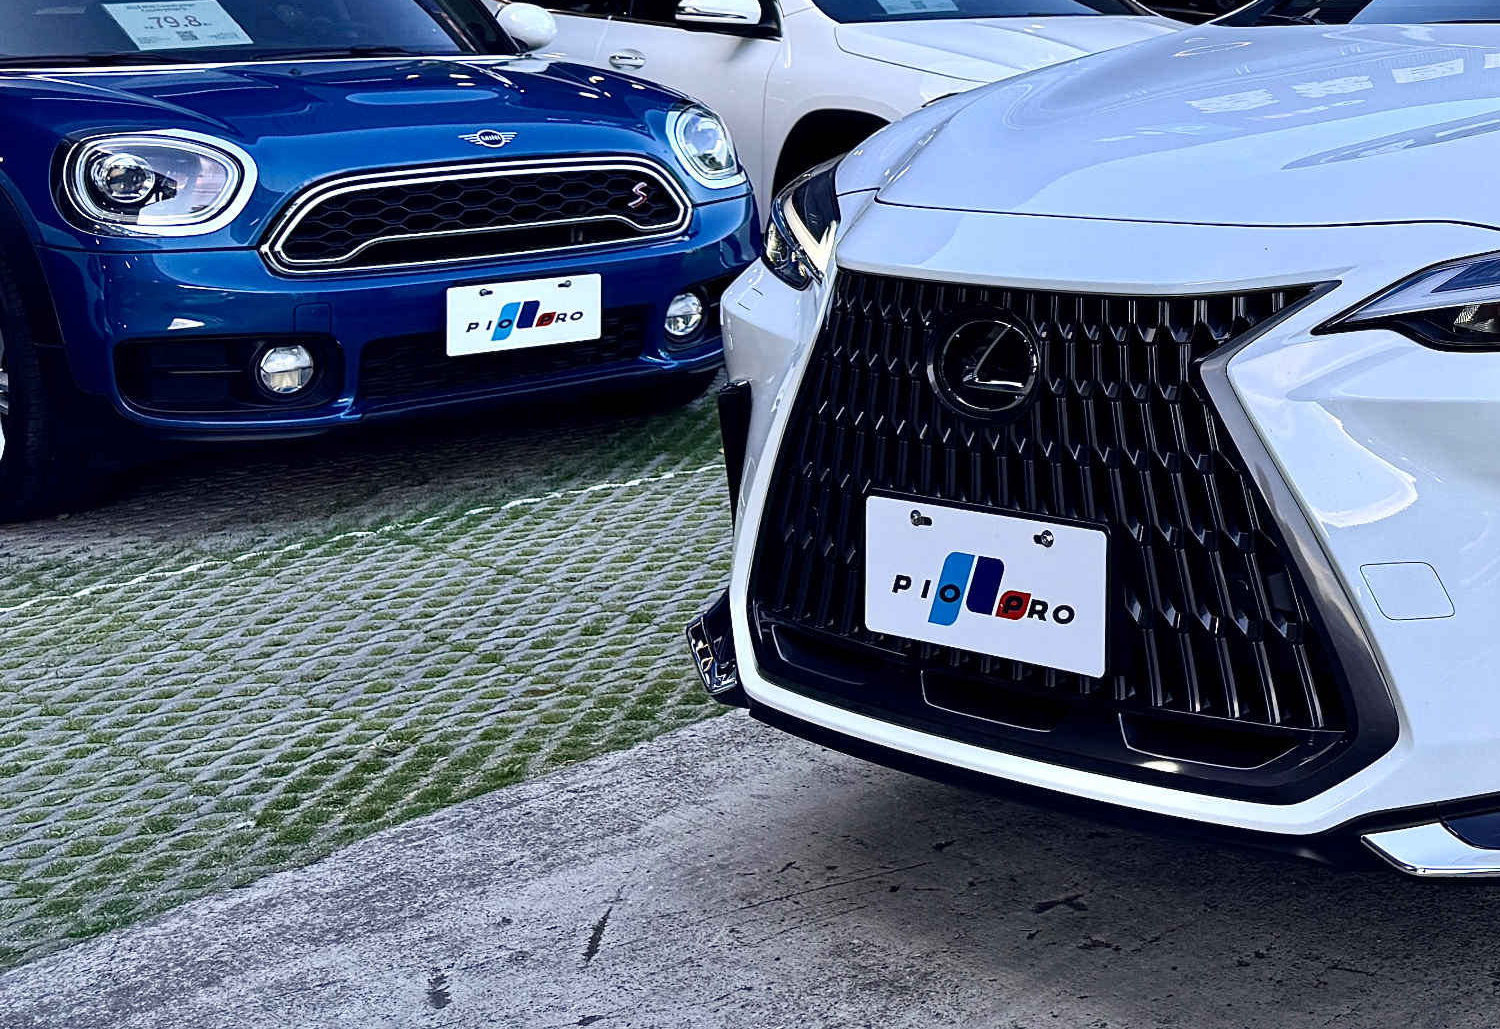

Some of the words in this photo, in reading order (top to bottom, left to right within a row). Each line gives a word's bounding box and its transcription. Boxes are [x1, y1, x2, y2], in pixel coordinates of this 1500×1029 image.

[148, 15, 202, 29] 79.8
[480, 134, 502, 142] MINI
[628, 182, 648, 209] S
[466, 318, 513, 333] PIO
[538, 311, 584, 326] PRO
[891, 574, 961, 604] PIO
[1002, 595, 1076, 625] PRO
